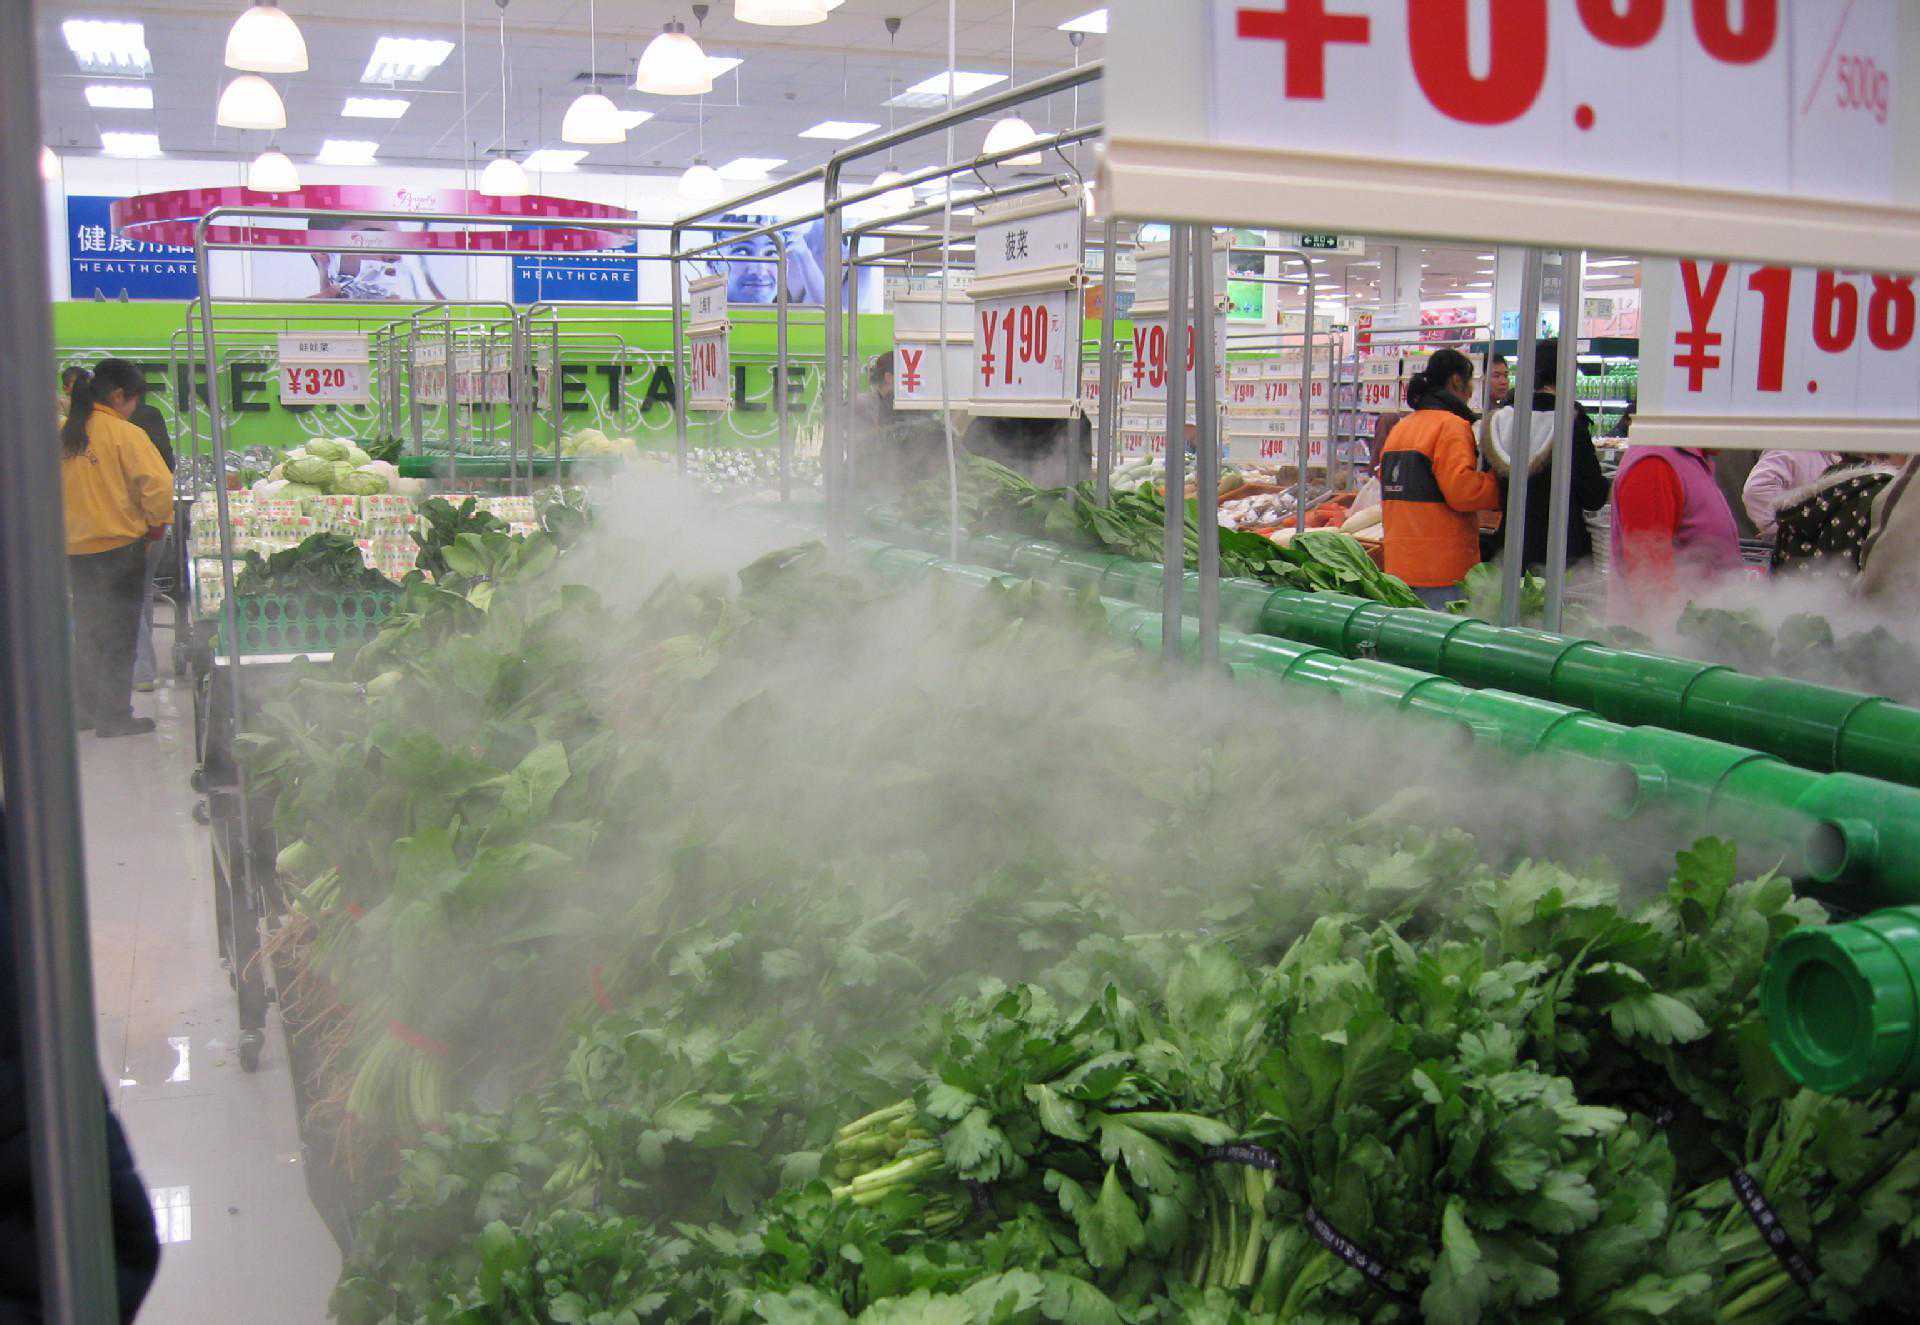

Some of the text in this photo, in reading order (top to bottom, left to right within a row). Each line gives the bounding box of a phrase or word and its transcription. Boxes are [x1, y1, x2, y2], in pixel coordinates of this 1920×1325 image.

[79, 264, 198, 274] HEALTHCARE
[522, 271, 631, 281] HEALTHCARE
[981, 305, 1048, 388] ¥1.90
